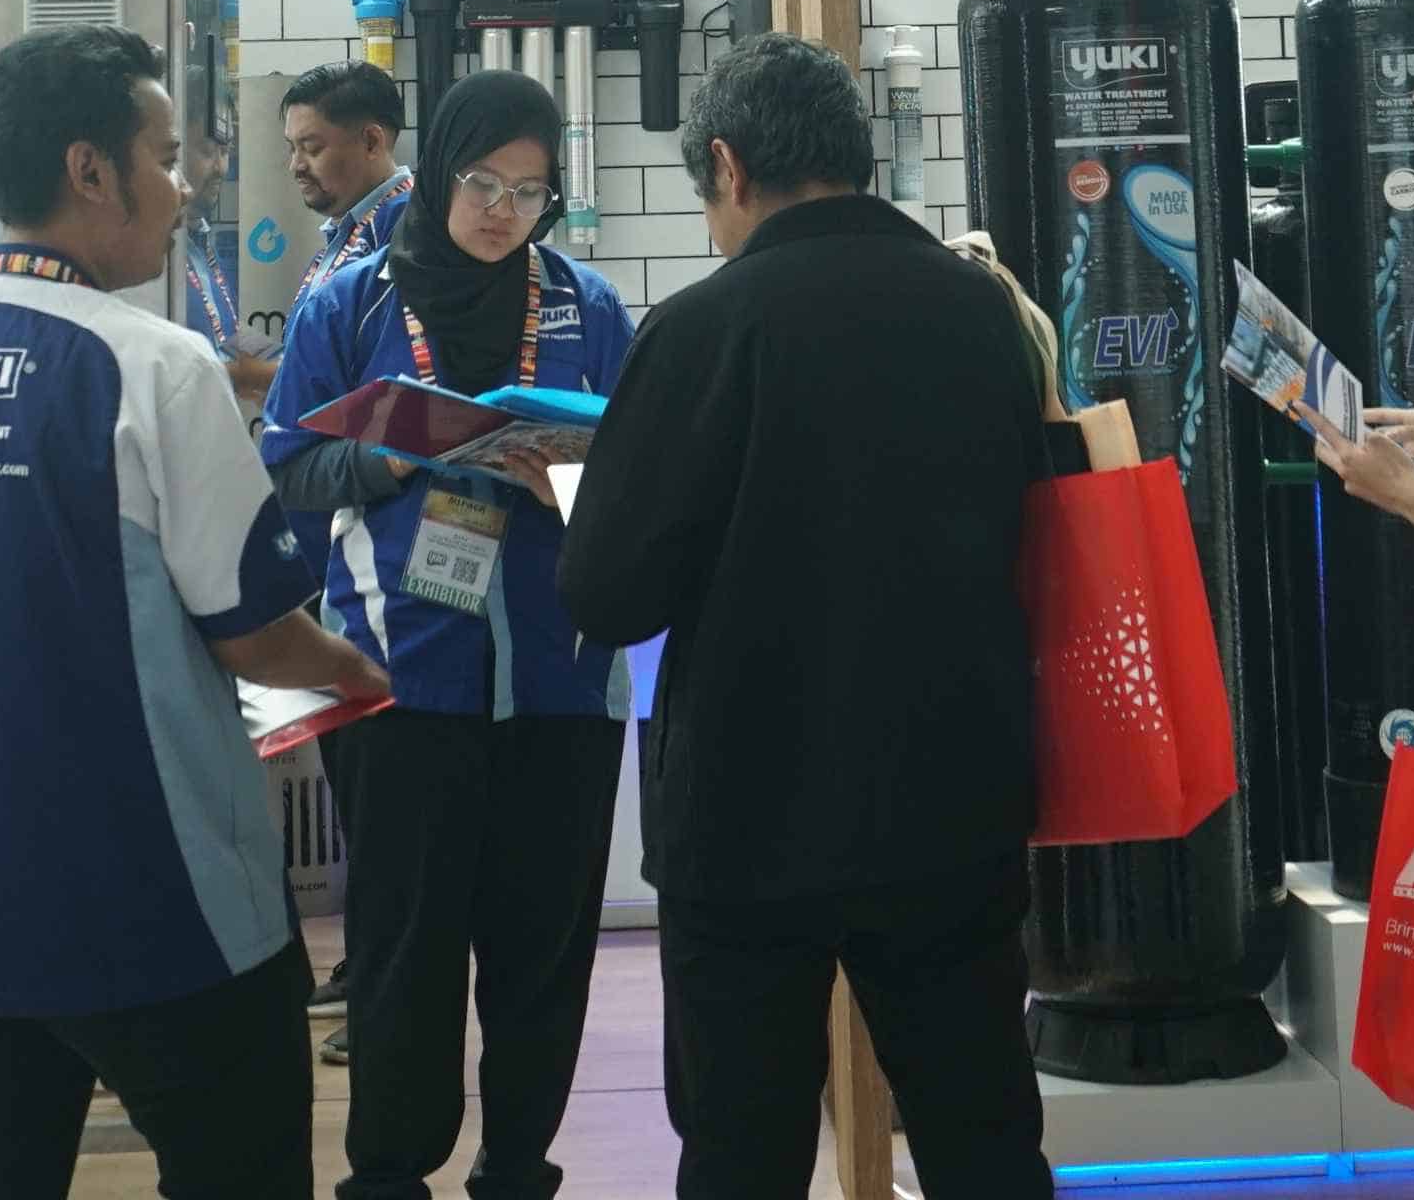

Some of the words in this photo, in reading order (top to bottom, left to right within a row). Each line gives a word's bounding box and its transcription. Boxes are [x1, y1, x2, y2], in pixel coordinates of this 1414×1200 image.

[1065, 91, 1102, 101] WATER
[1105, 89, 1167, 99] TREATMENT
[1148, 190, 1189, 203] MADE
[1164, 201, 1189, 215] USA
[407, 577, 481, 614] EXHIBITOR
